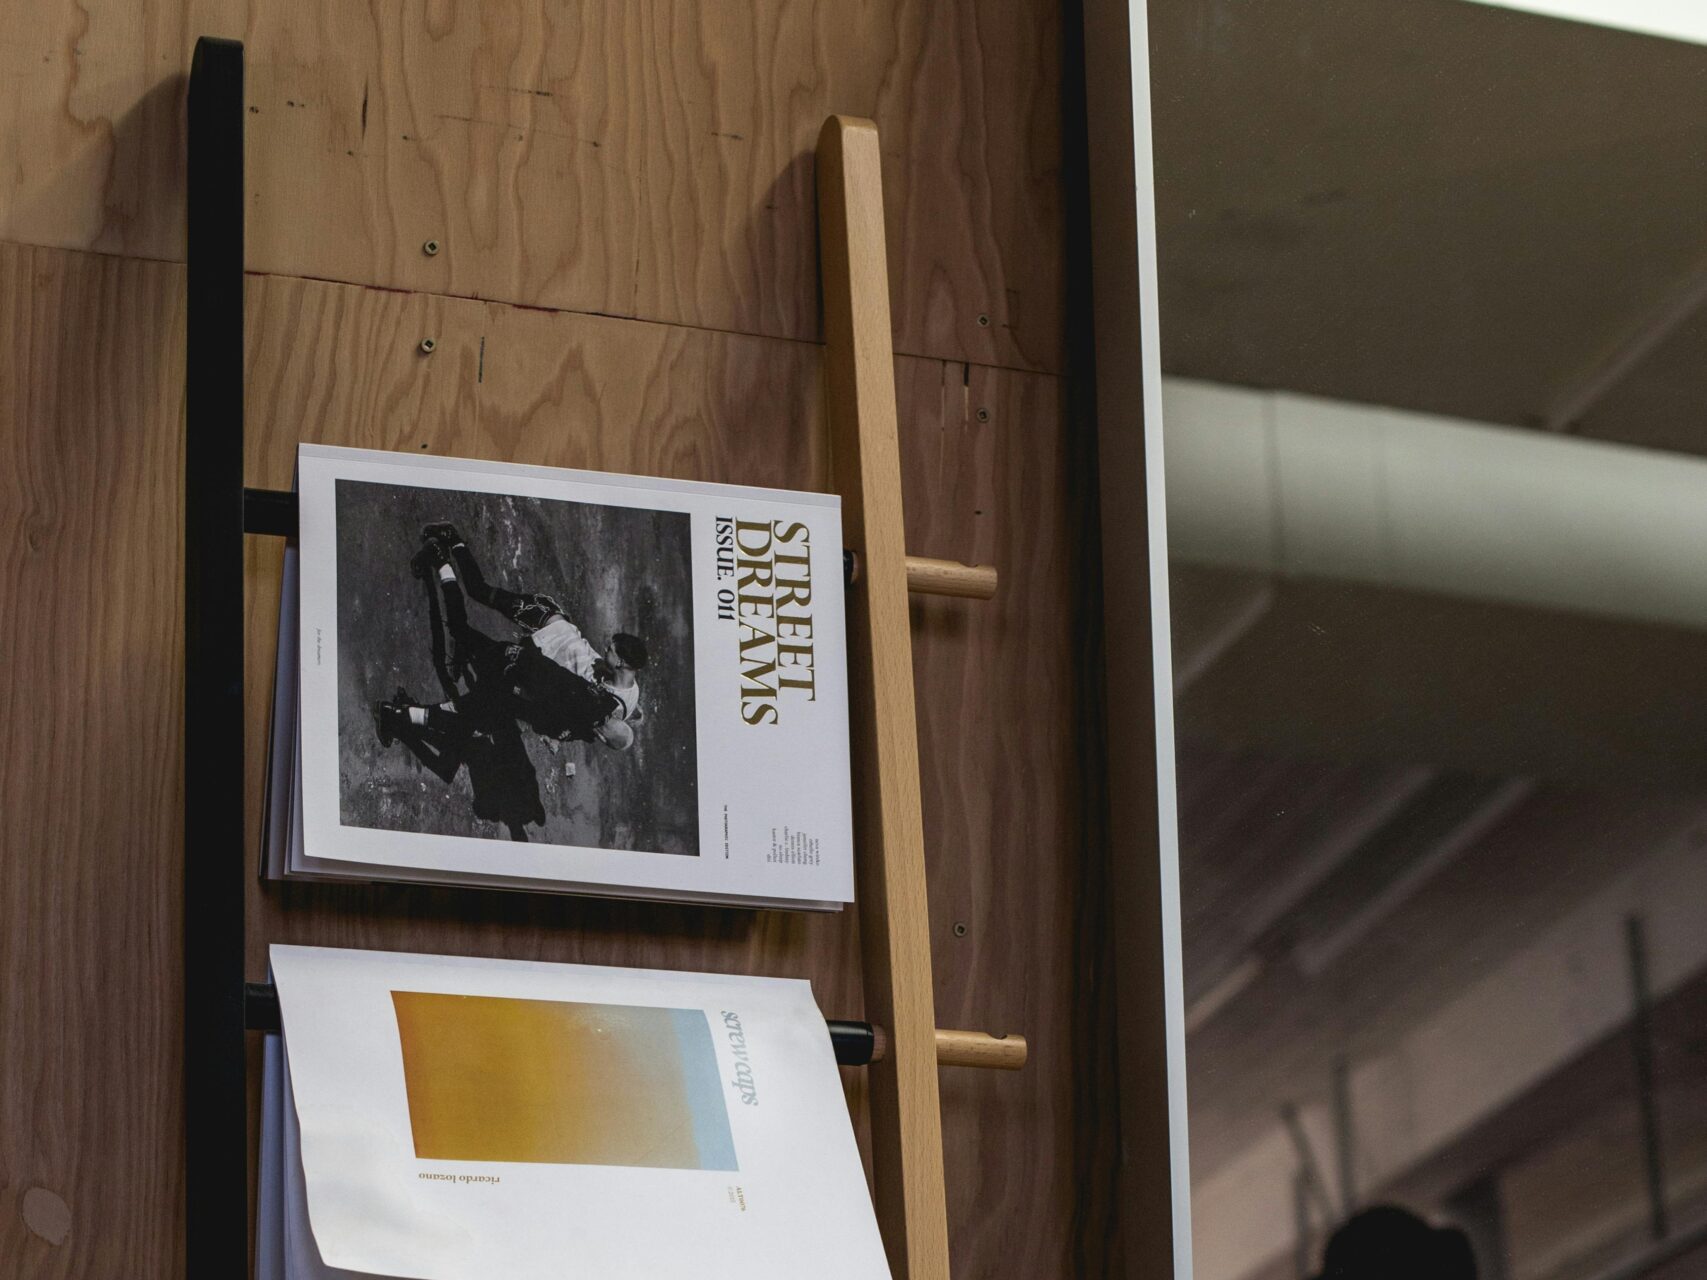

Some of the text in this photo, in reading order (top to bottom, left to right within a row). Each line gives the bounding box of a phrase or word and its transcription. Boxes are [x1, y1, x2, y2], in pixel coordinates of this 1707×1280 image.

[716, 516, 735, 621] ISSUE. 011
[736, 519, 779, 726] DREAMS
[772, 520, 816, 702] STREET
[419, 1173, 500, 1184] ricardo lozano
